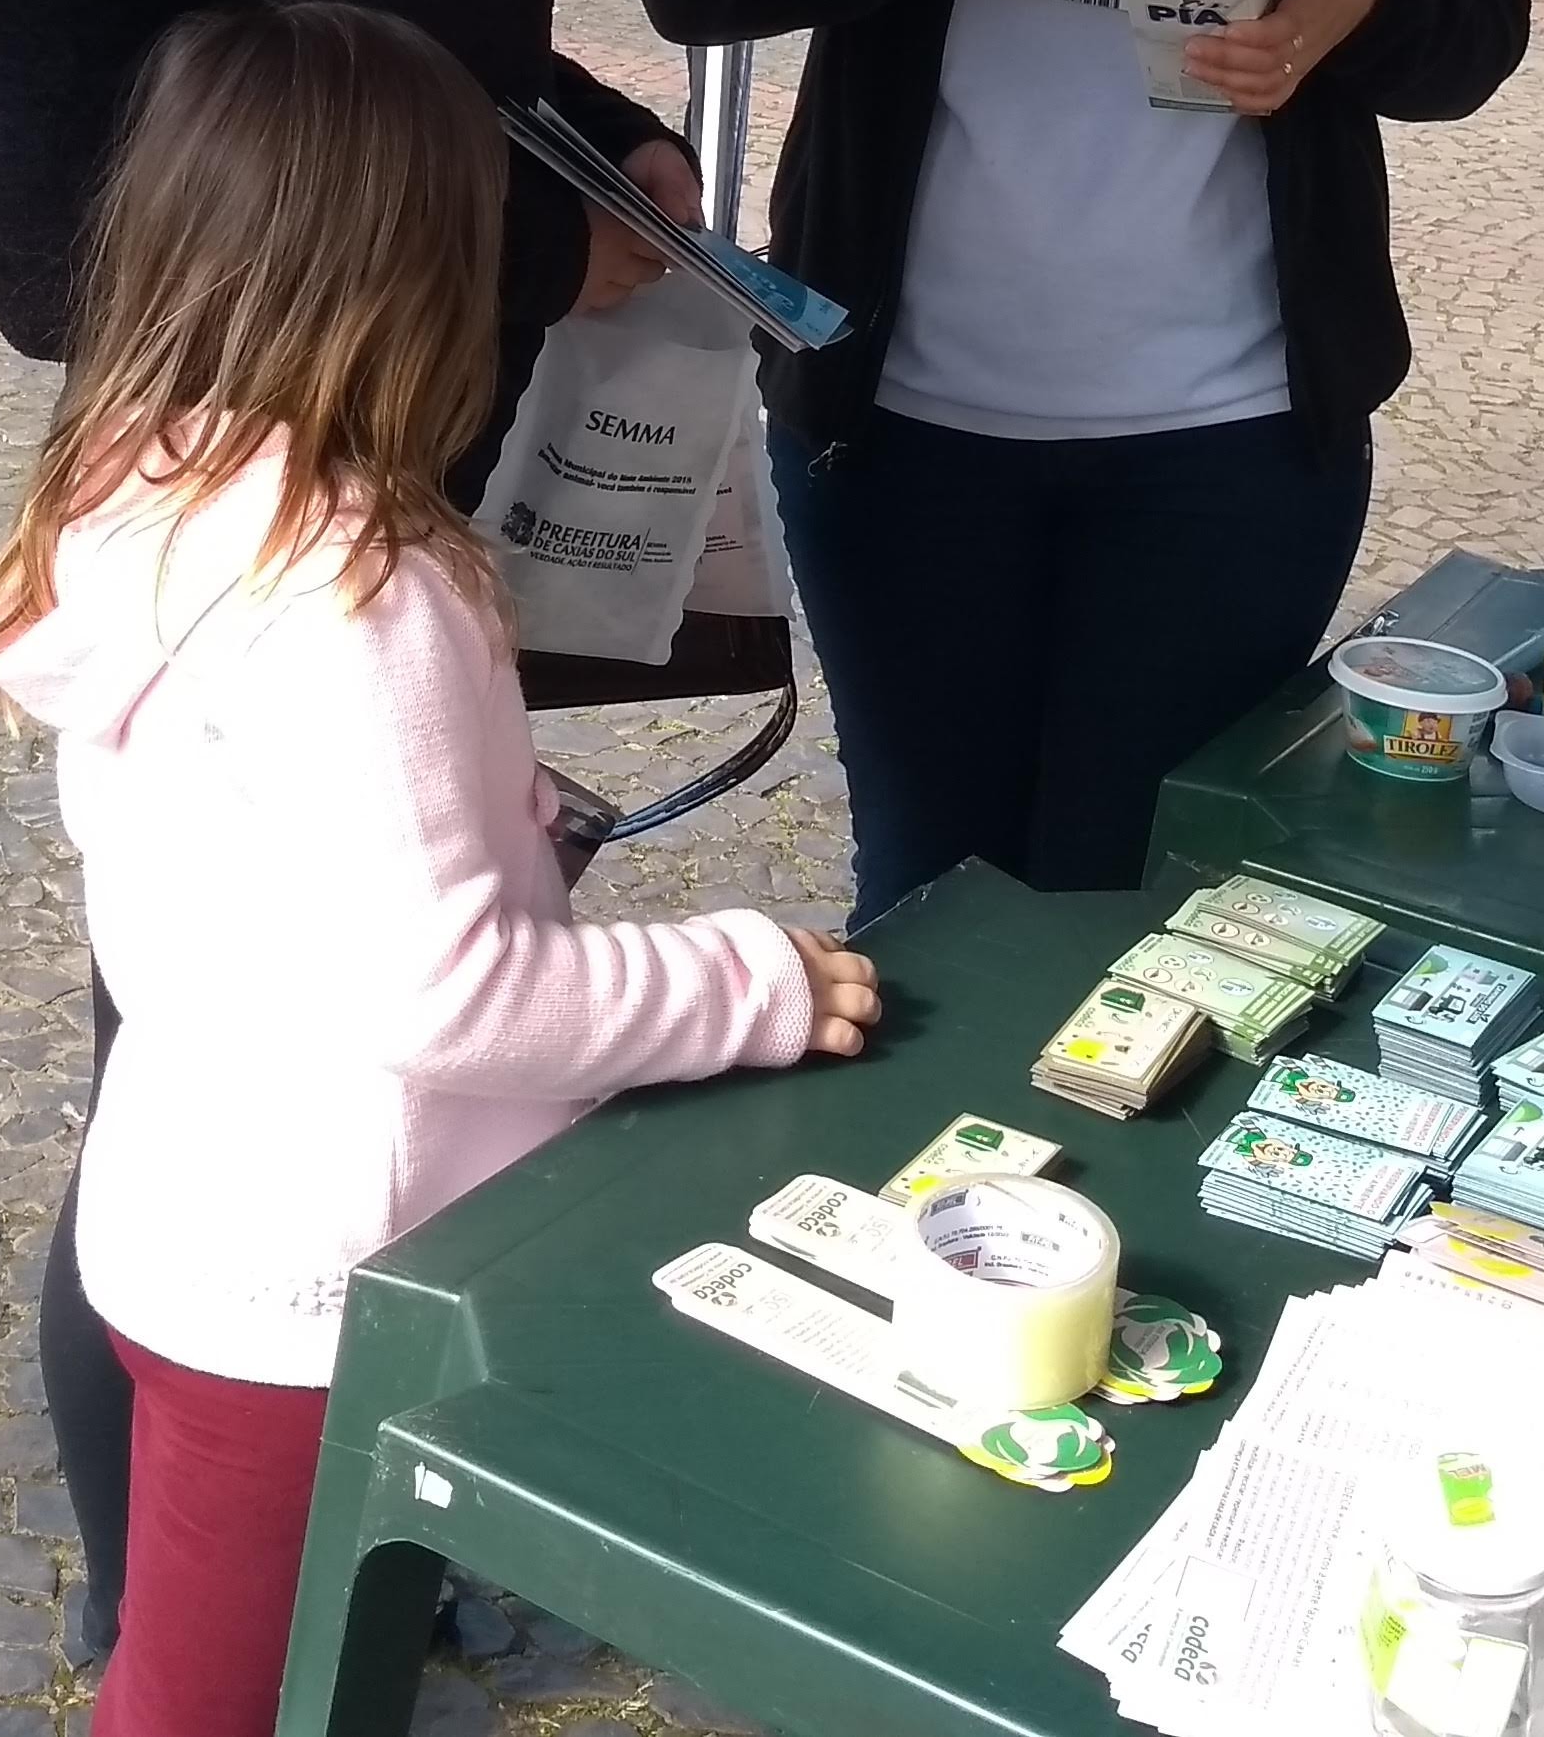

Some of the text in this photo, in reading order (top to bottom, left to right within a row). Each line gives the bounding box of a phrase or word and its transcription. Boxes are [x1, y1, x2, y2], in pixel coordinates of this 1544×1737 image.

[585, 410, 676, 445] SEMMA
[564, 459, 606, 480] Municipal
[607, 470, 618, 482] do
[532, 536, 551, 552] DE
[552, 540, 594, 559] CAXIAS
[595, 548, 614, 561] DO
[616, 549, 635, 563] SUL
[537, 518, 642, 551] PREFEITURA
[1386, 737, 1461, 757] TIROLEZ
[797, 1191, 848, 1232] codeca
[692, 1262, 753, 1301] codeca
[1175, 1614, 1210, 1682] codeca
